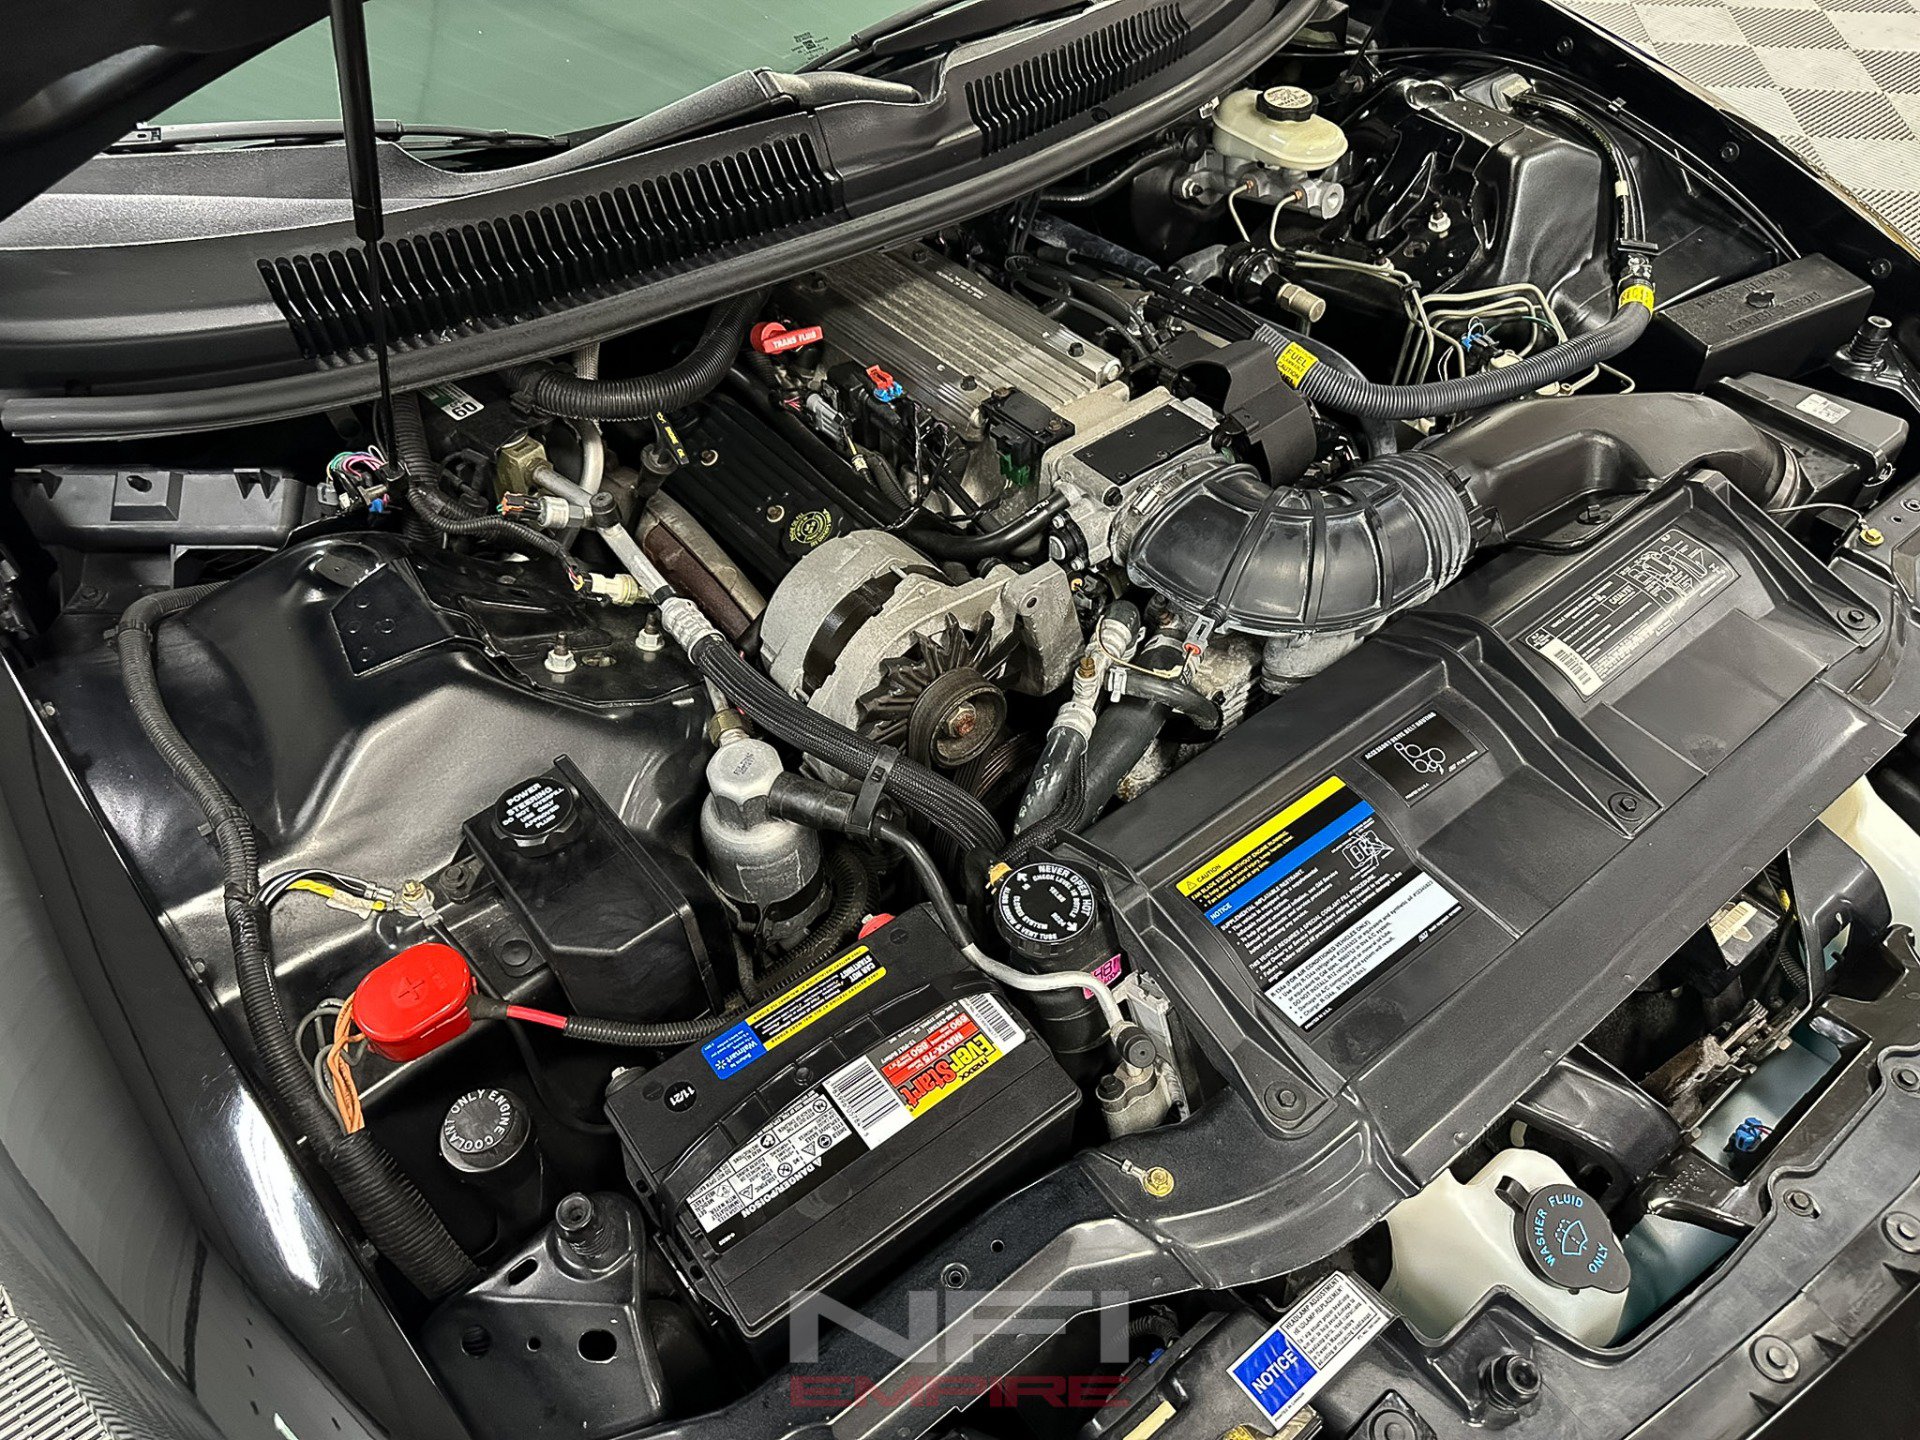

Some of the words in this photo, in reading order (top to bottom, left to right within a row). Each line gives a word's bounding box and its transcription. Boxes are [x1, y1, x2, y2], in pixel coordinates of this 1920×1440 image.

[1285, 348, 1307, 368] FUEL
[506, 783, 542, 806] POWER
[506, 786, 553, 816] STEERING
[1055, 876, 1073, 890] LEVEL
[1196, 864, 1221, 882] CAUTION
[1038, 865, 1070, 878] NEVER
[1070, 875, 1090, 897] OPEN
[1081, 899, 1092, 917] HOT
[1191, 891, 1201, 900] FAN
[1200, 881, 1216, 893] BLADE
[1210, 902, 1231, 919] NOTICE
[1020, 926, 1038, 938] VENT
[849, 970, 862, 982] NOT
[860, 962, 875, 973] CAR
[949, 1014, 968, 1029] 690
[725, 1040, 757, 1062] Walmart
[897, 1031, 996, 1109] EverStart
[959, 1058, 988, 1080] maxx
[450, 1089, 485, 1113] ONLY
[670, 1086, 695, 1106] 11/21
[488, 1090, 511, 1135] ENGINE
[444, 1118, 494, 1150] COOLANT
[741, 1163, 815, 1217] DANGER/POISON
[1534, 1208, 1556, 1267] WASHER
[1548, 1193, 1584, 1208] FLUID
[1588, 1241, 1608, 1274] ONLY
[1285, 1304, 1309, 1329] HEADLAMP
[1309, 1278, 1338, 1306] ADJUSTMENT
[1252, 1349, 1296, 1393] NOTICE
